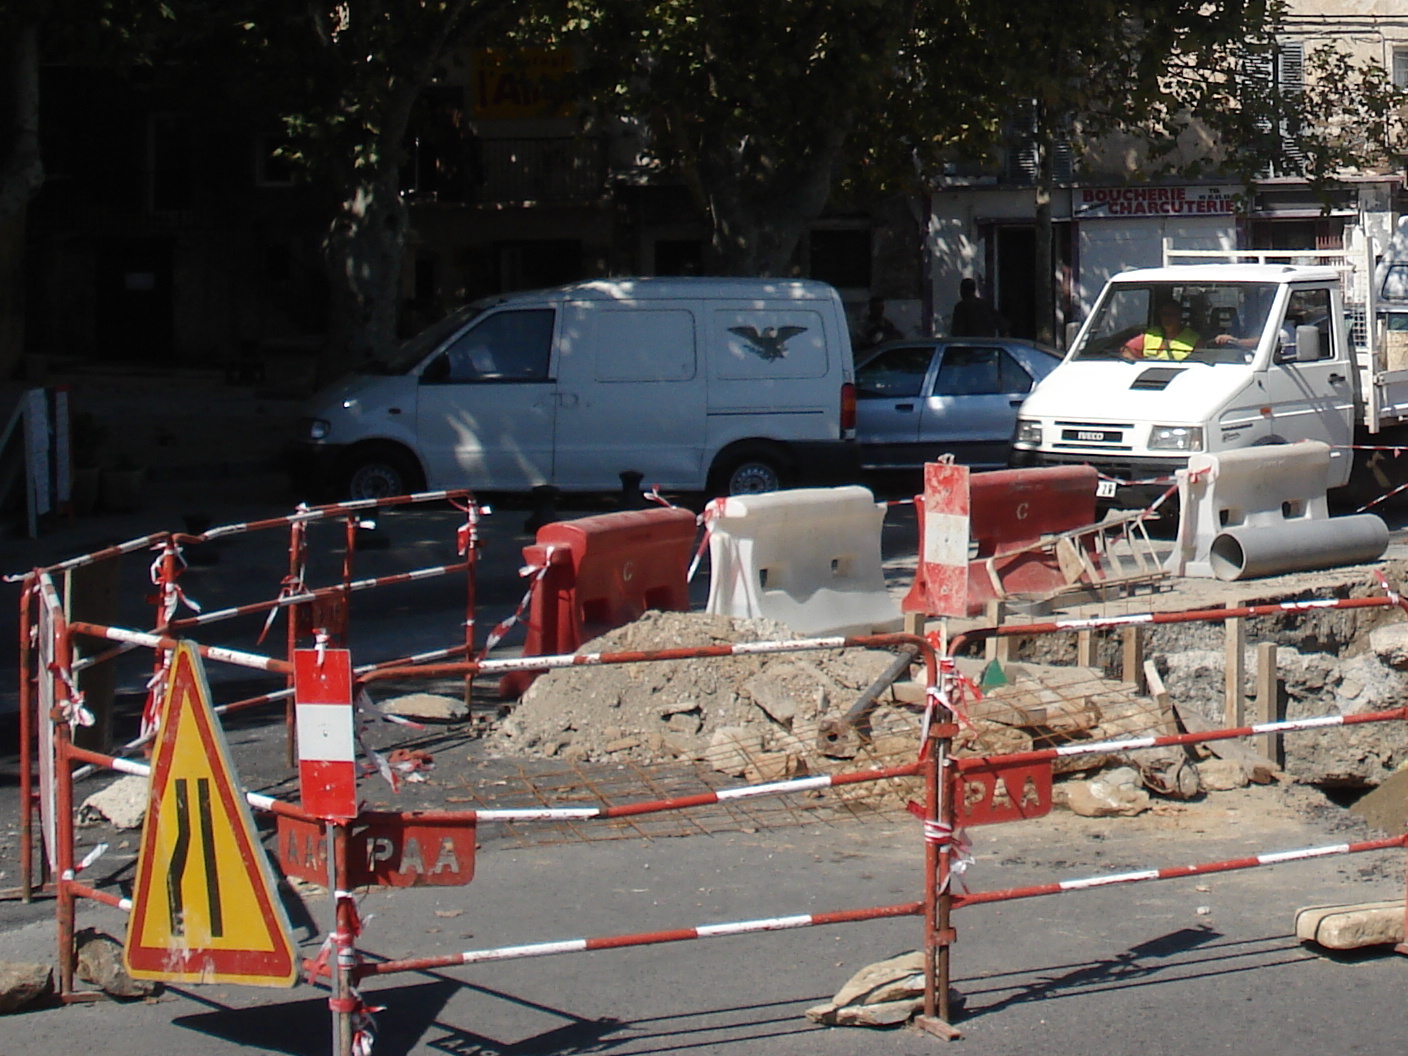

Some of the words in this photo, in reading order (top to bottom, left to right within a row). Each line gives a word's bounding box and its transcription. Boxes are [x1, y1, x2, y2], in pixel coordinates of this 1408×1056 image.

[1082, 187, 1186, 203] BOUCHERIE
[1107, 200, 1235, 215] CHARCUTERIE
[1077, 431, 1105, 441] IVECO
[963, 775, 1041, 818] PAA
[366, 836, 461, 876] PAA
